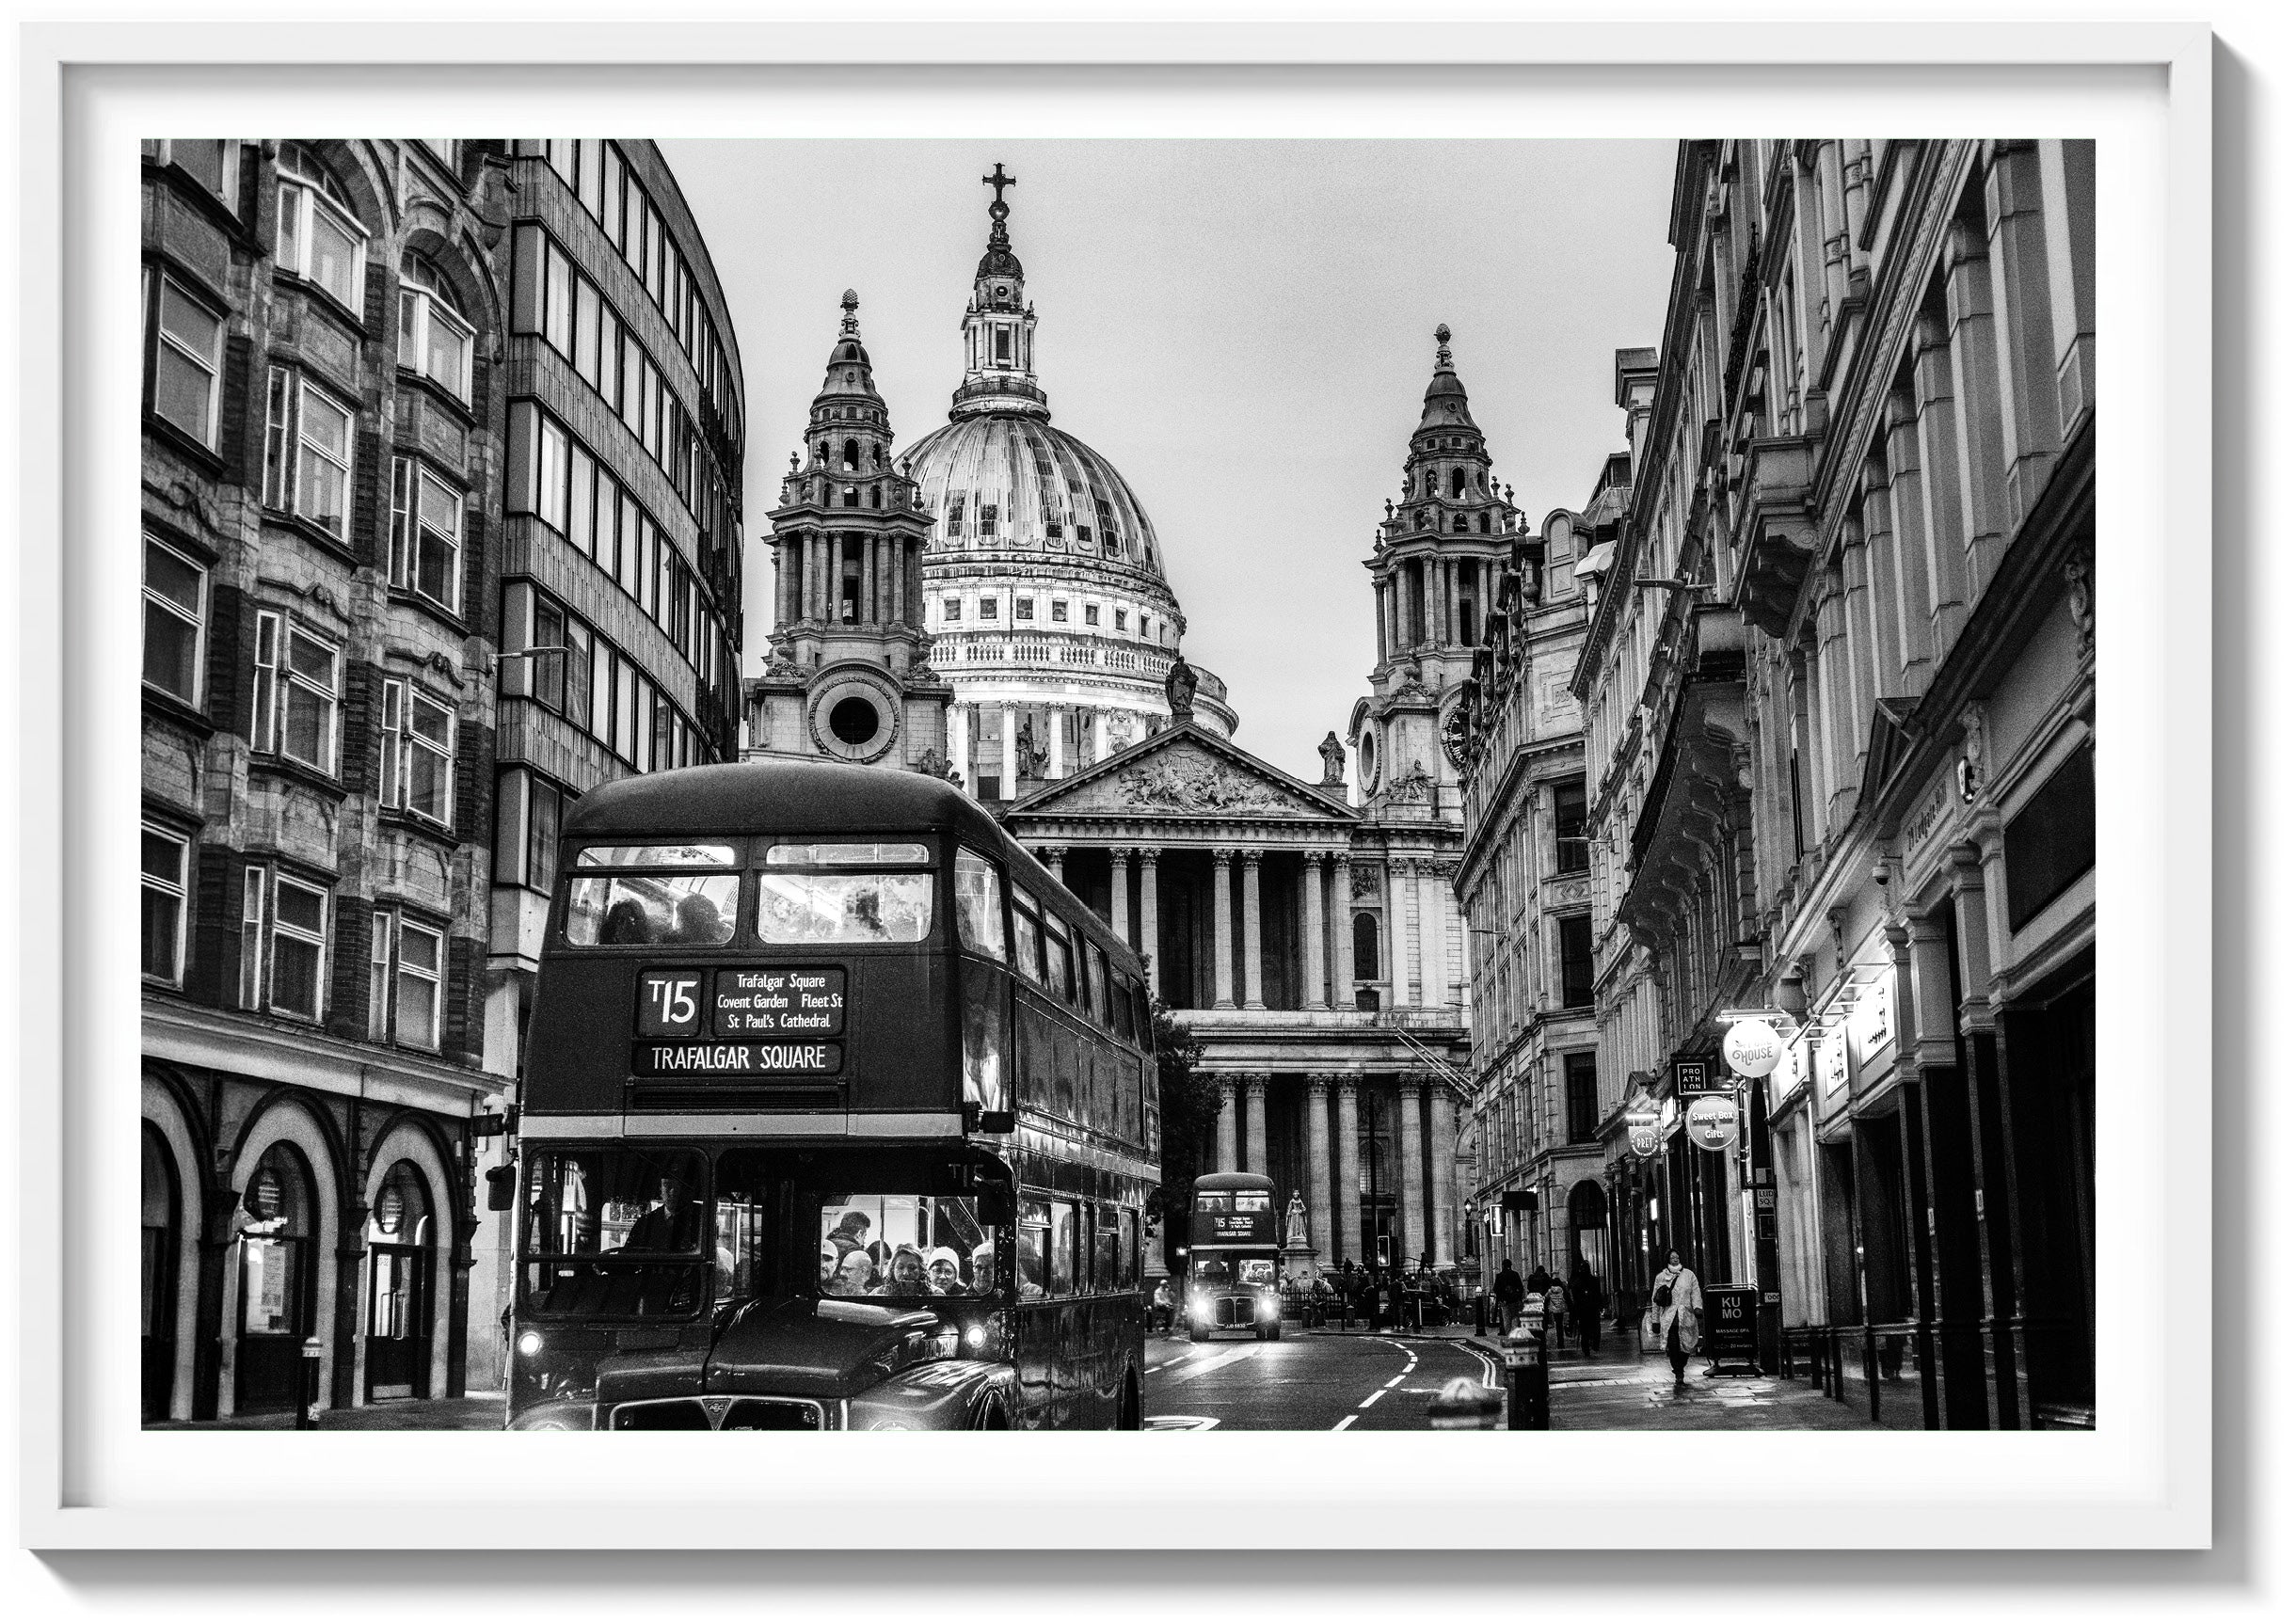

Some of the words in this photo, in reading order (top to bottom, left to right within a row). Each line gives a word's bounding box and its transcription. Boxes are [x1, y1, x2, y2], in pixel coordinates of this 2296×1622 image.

[737, 974, 785, 992] Trafalgar
[789, 973, 825, 993] Square
[647, 980, 698, 1024] T15
[718, 994, 751, 1009] Covent
[754, 994, 789, 1009] Garden
[801, 994, 829, 1008] Fleet
[830, 994, 843, 1008] St
[727, 1014, 740, 1028] St
[746, 1014, 774, 1028] Paul's
[780, 1013, 831, 1028] Cathedral
[651, 1046, 750, 1070] TRAFALGAR
[759, 1045, 826, 1069] SQUARE
[1732, 1046, 1773, 1066] HOUSE
[1692, 1111, 1716, 1121] Sweet
[1718, 1111, 1733, 1120] Box
[1704, 1129, 1724, 1138] Gifts
[1637, 1137, 1653, 1148] PRET
[1214, 1217, 1225, 1228] T15
[1721, 1296, 1741, 1308] KU
[1721, 1308, 1742, 1319] MO
